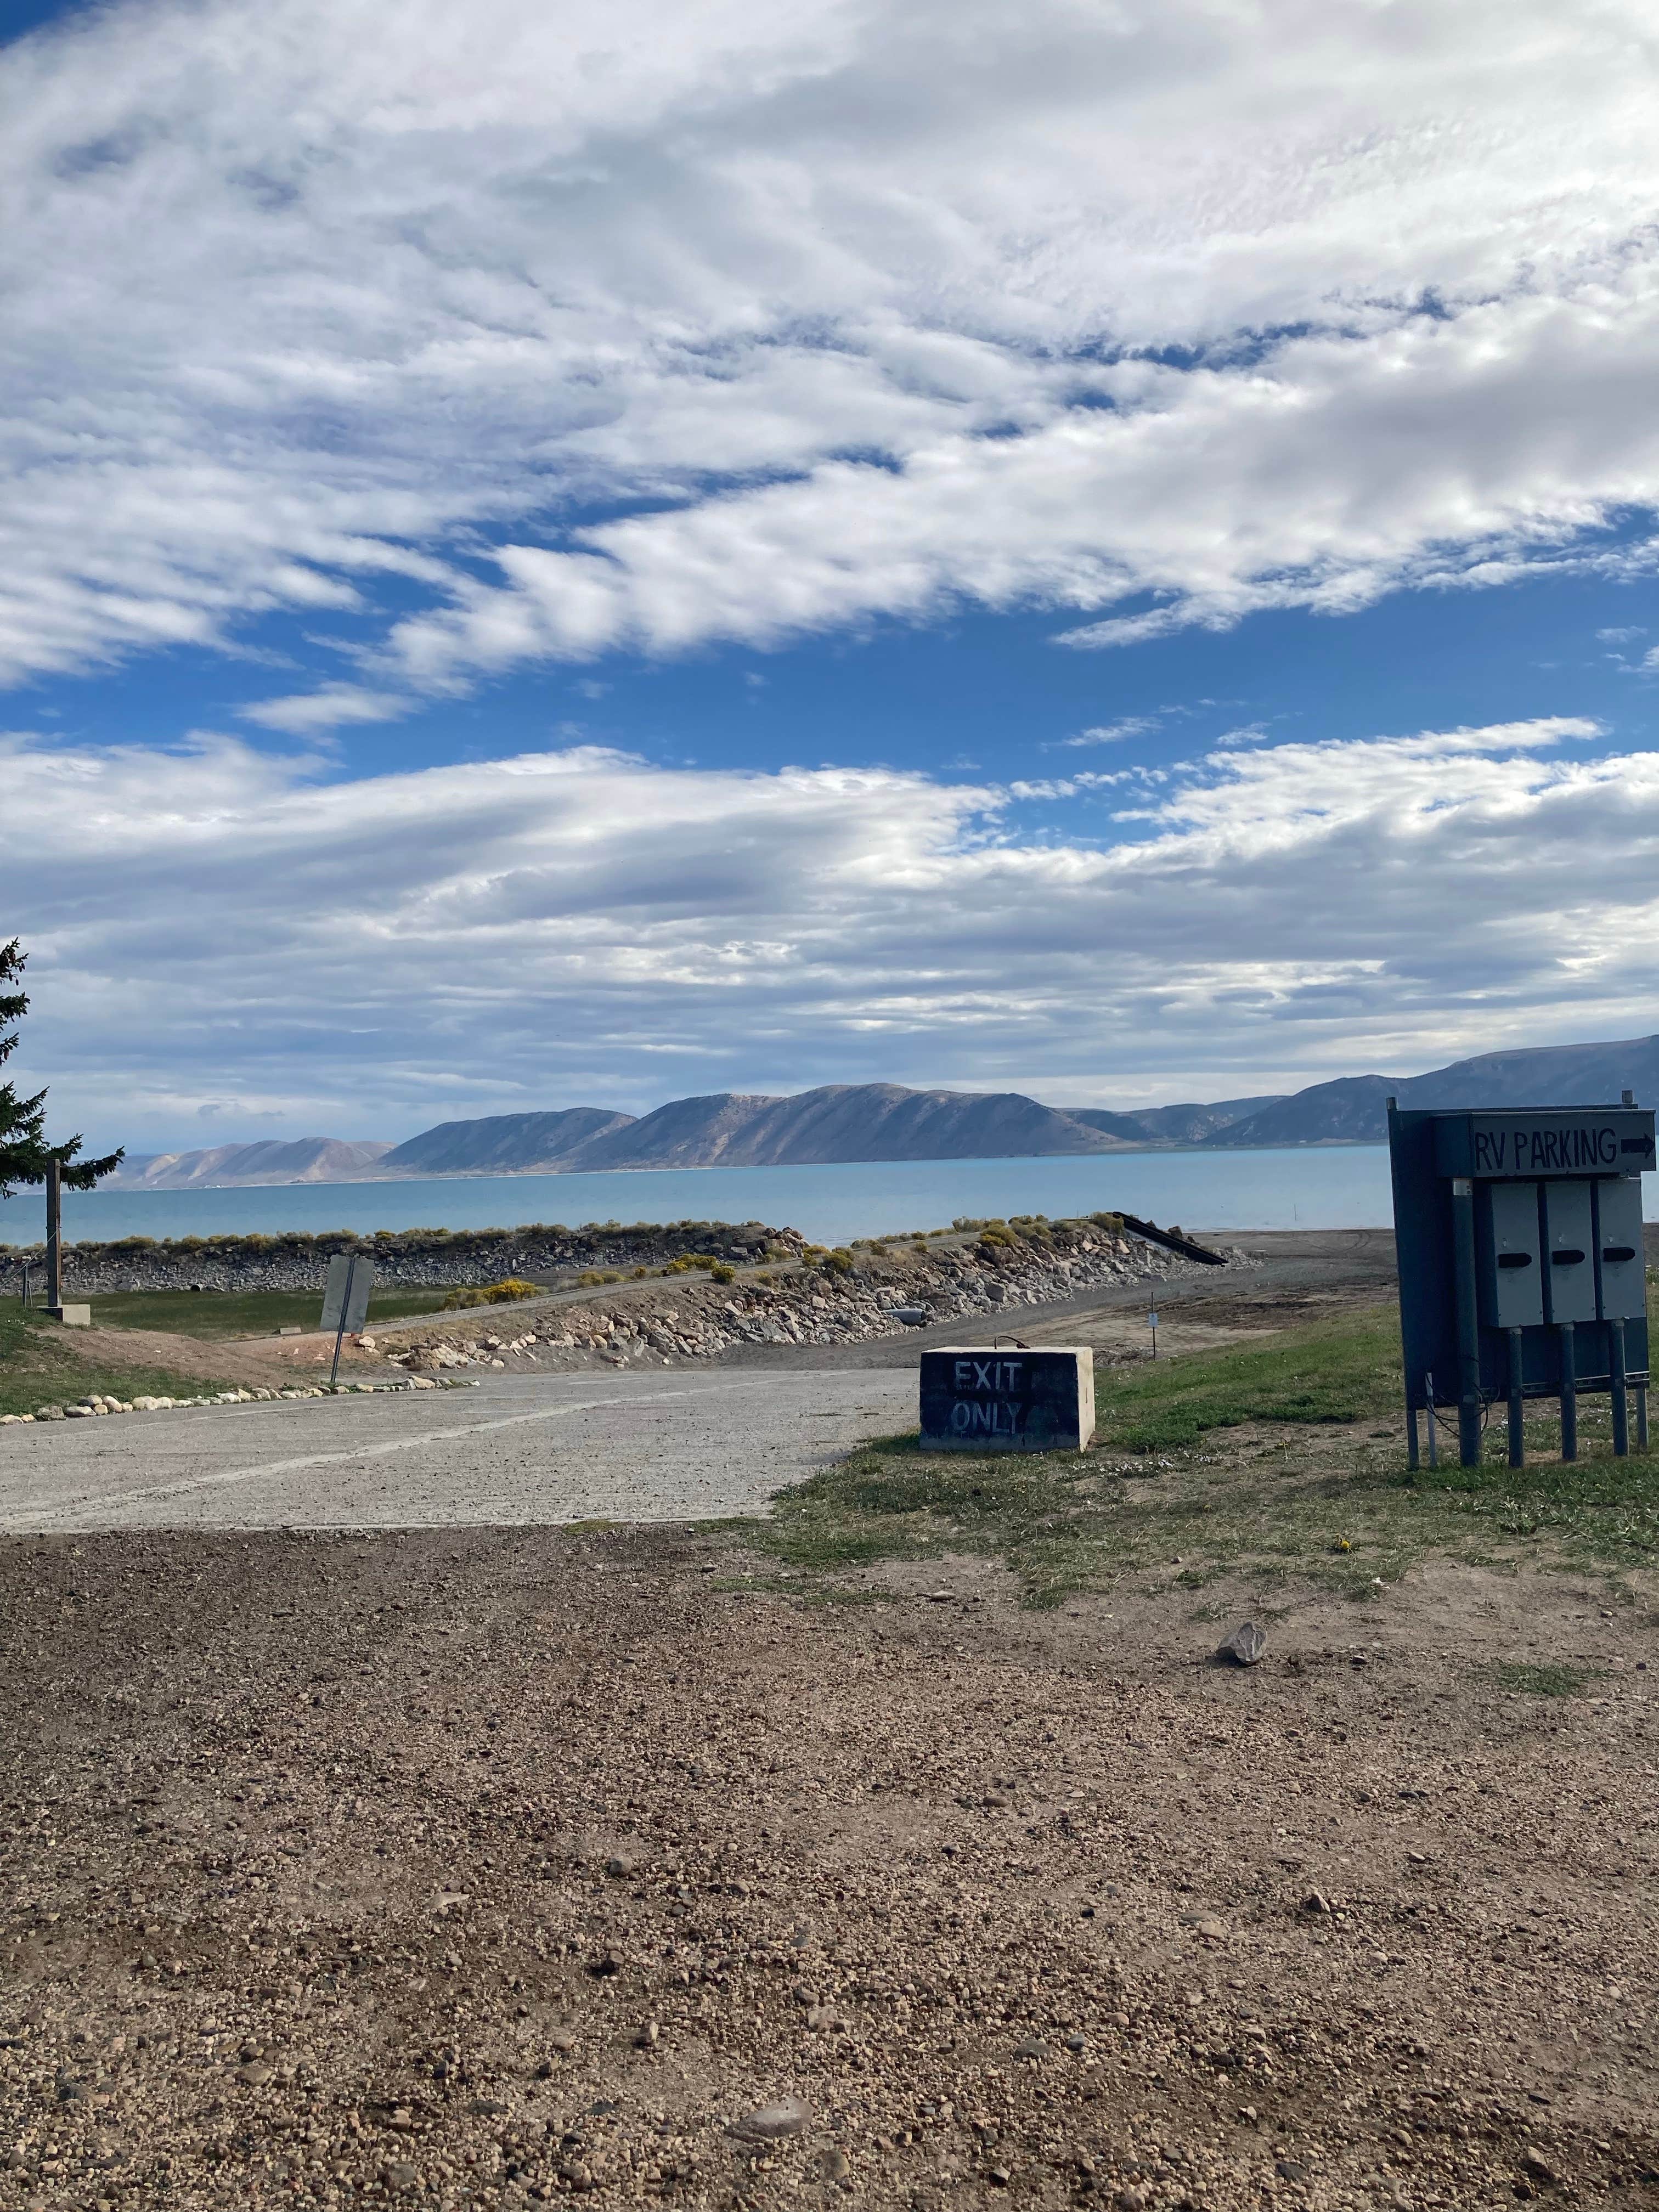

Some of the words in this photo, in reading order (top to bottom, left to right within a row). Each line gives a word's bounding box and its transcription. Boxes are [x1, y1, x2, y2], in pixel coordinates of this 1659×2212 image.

[1475, 1132, 1505, 1170] RV
[1514, 1128, 1617, 1170] PARKING
[955, 1361, 1023, 1391] EXIT
[951, 1402, 1023, 1434] ONLY
